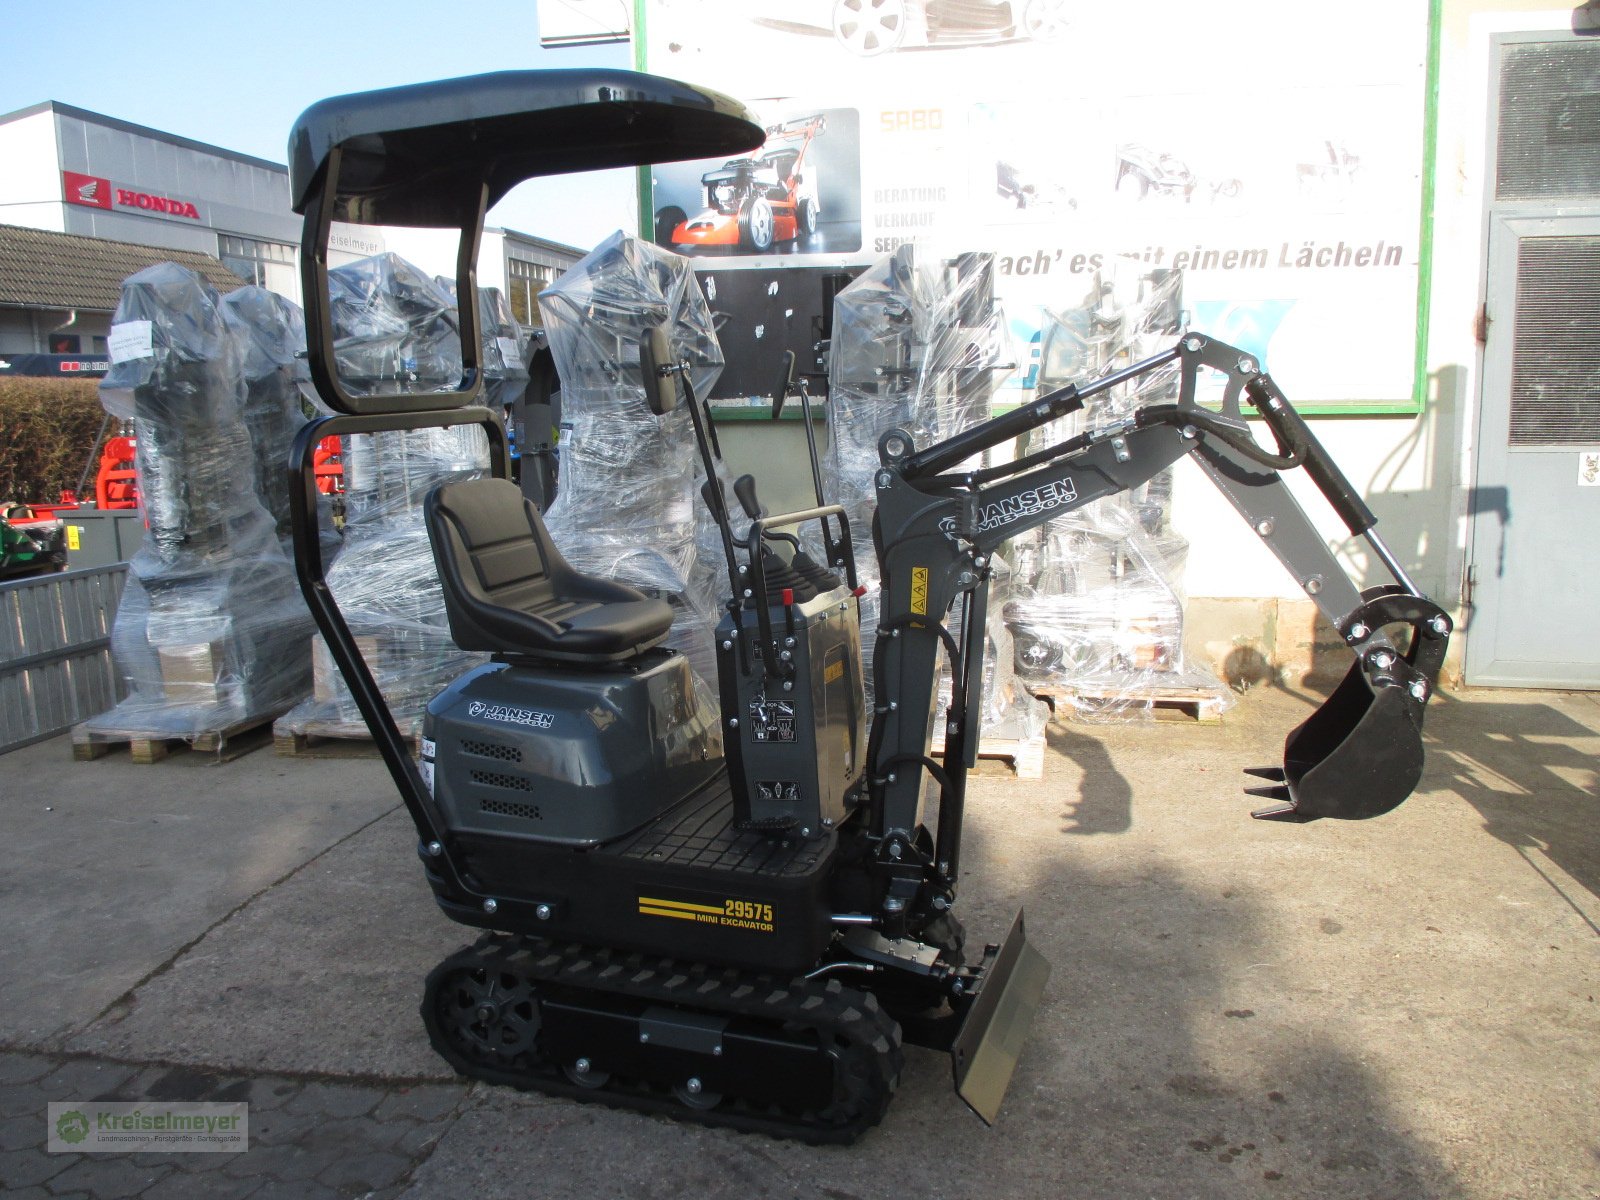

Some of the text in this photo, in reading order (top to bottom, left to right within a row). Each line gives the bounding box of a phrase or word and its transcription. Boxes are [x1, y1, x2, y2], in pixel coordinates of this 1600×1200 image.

[880, 109, 943, 131] SABO
[117, 189, 200, 219] HONDA
[874, 187, 947, 204] BERATUNG
[874, 211, 935, 228] VERKAUF
[999, 249, 1063, 276] ach’
[1069, 253, 1104, 274] es
[1172, 245, 1268, 270] einem
[1278, 240, 1403, 268] Lächeln
[486, 706, 555, 724] JANSEN
[725, 900, 773, 922] 29575
[697, 914, 774, 932] MINI EXCAVATOR
